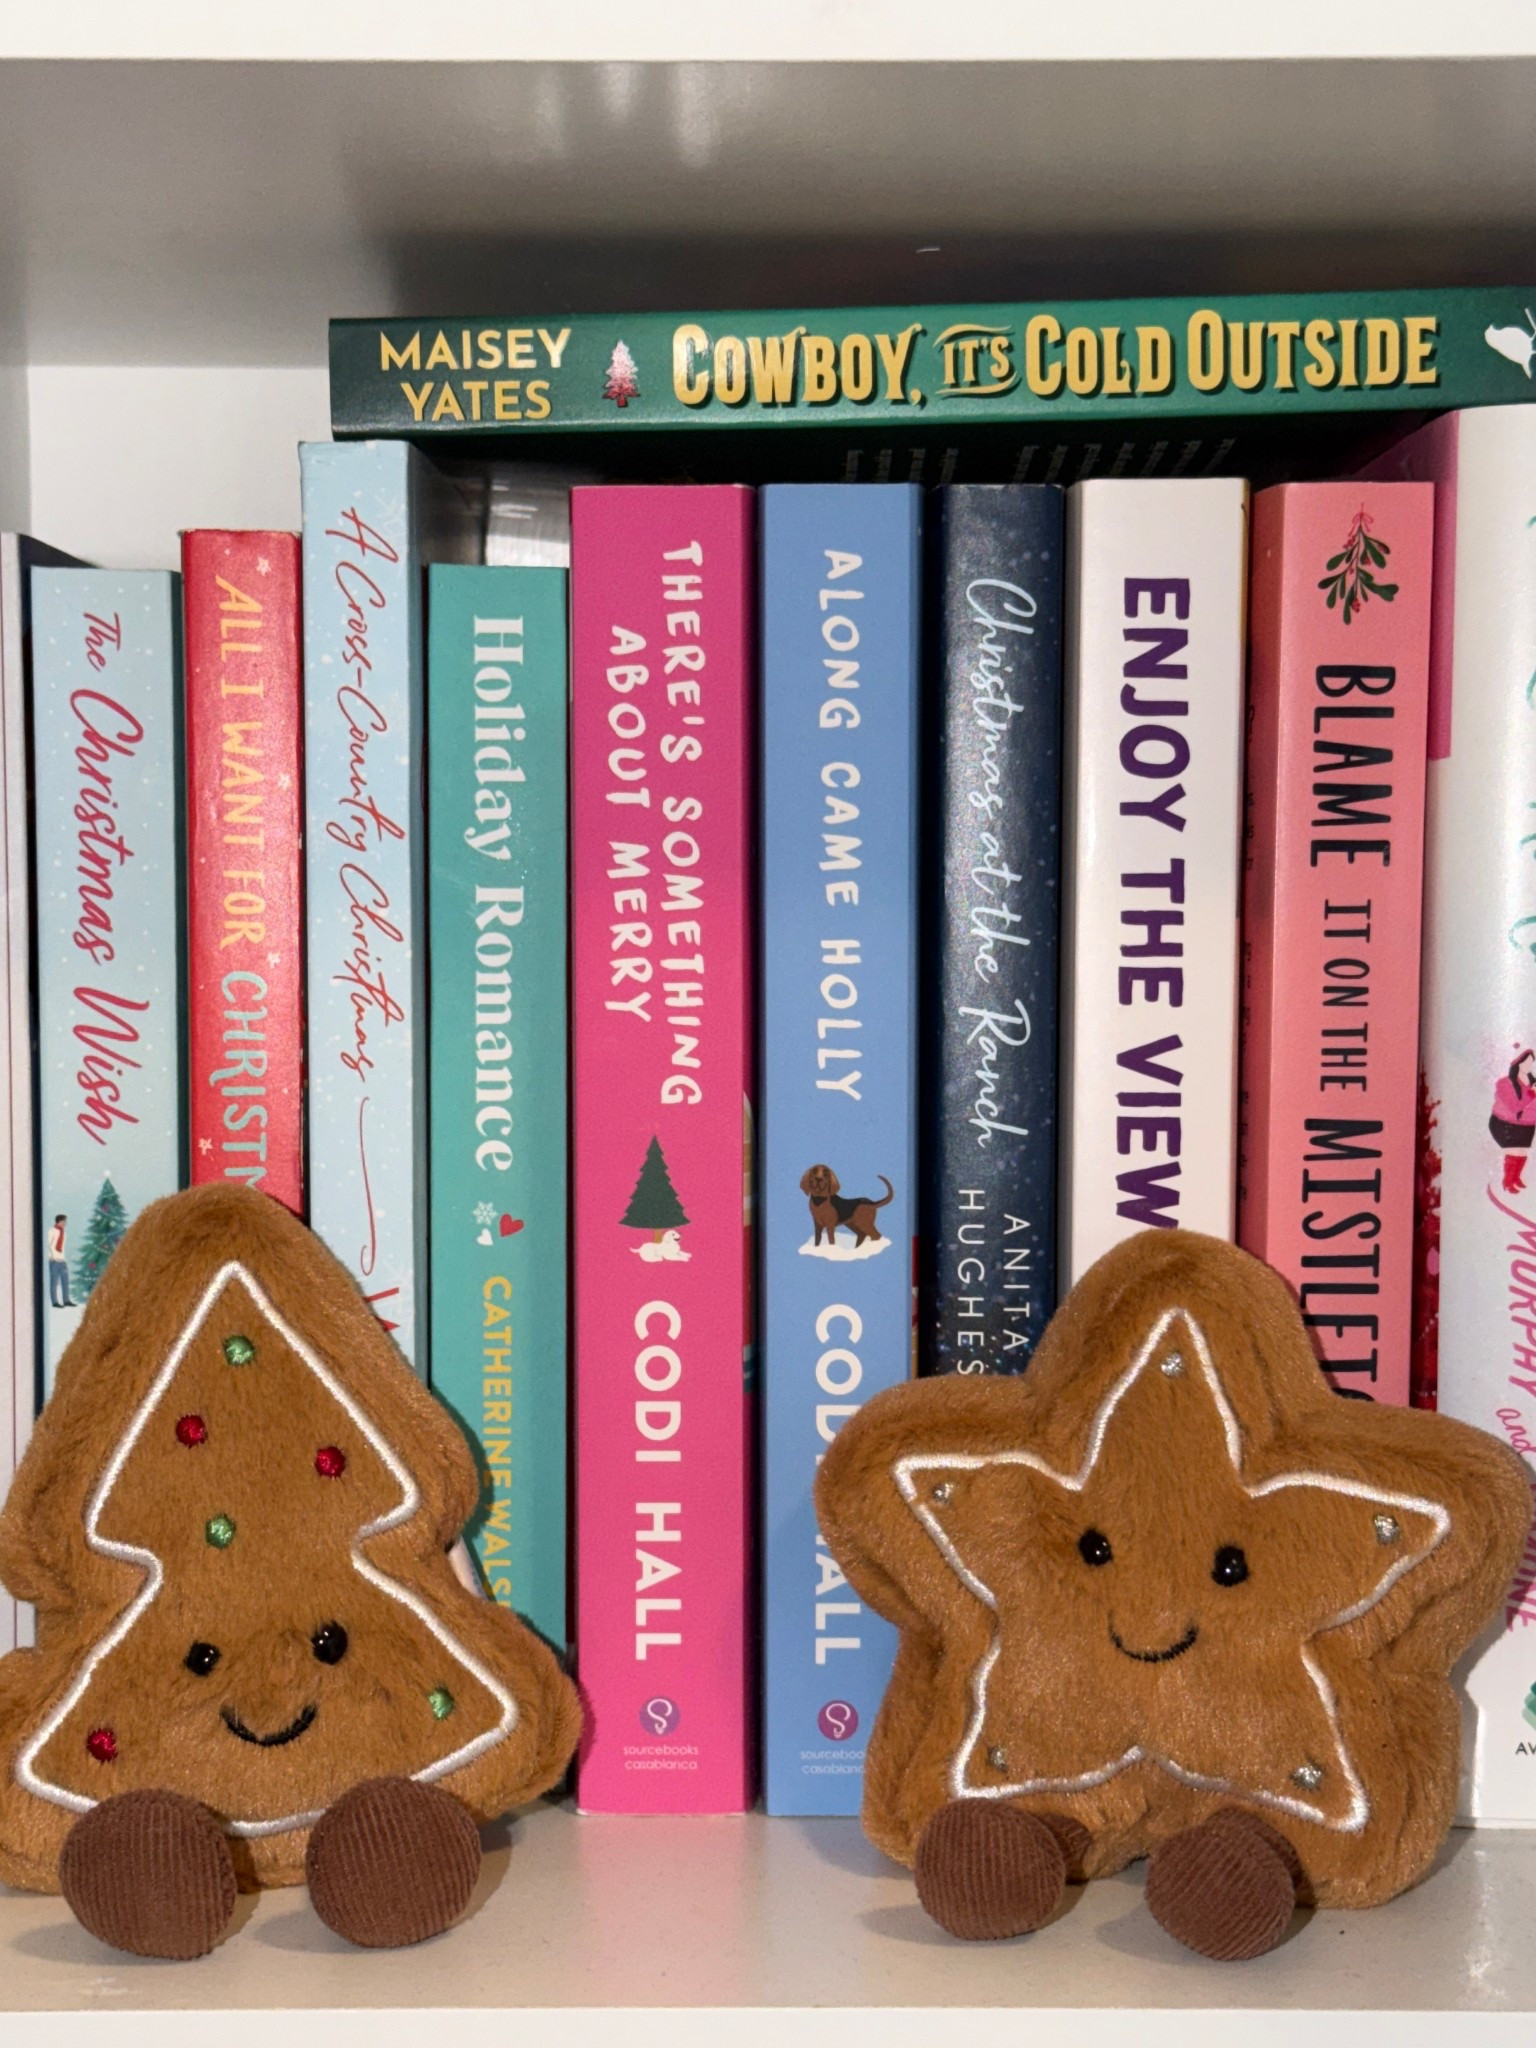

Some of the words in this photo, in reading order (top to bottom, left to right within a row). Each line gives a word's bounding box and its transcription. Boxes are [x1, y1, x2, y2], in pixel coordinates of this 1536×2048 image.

[381, 329, 571, 371] MAISEY
[400, 379, 553, 421] YATES
[325, 506, 399, 563] A
[84, 612, 121, 671] The
[215, 574, 264, 662] ALL
[220, 679, 265, 699] I
[660, 540, 706, 763] THERE'S
[819, 549, 865, 729] ALONG
[326, 561, 405, 851] Cross-Country
[464, 615, 526, 860] Holiday
[606, 625, 651, 808] ABOUT
[966, 578, 1037, 820] Christmas
[1119, 577, 1191, 833] ENJOY
[1310, 664, 1397, 868] BLAME
[70, 689, 144, 965] Christmas
[221, 721, 267, 853] WANT
[819, 762, 862, 906] CAME
[971, 831, 1023, 895] at
[219, 867, 267, 950] FOR
[333, 862, 405, 1082] Christmas
[605, 841, 652, 1022] MERRY
[660, 796, 705, 1105] SOMETHING
[971, 902, 1031, 983] the
[1119, 857, 1185, 1008] THE
[1322, 958, 1370, 1007] ON
[1323, 899, 1372, 944] IT
[73, 986, 150, 1145] Wish
[475, 885, 525, 1171] Romance
[816, 939, 863, 1100] HOLLY
[958, 999, 1033, 1148] Ranch
[1320, 1022, 1369, 1092] THE
[1115, 1033, 1184, 1230] VIEW
[957, 1189, 985, 1375] HUGHES
[1003, 1213, 1031, 1351] ANITA
[1300, 1118, 1384, 1401] MISTLET
[483, 1276, 512, 1488] CATHERINE
[635, 1300, 682, 1462] CODI
[815, 1304, 863, 1465] COD
[483, 1496, 511, 1607] WALS
[635, 1502, 682, 1661] HALL
[815, 1534, 861, 1665] ALL
[623, 1744, 699, 1756] sourcebooks
[624, 1759, 698, 1770] casablanca
